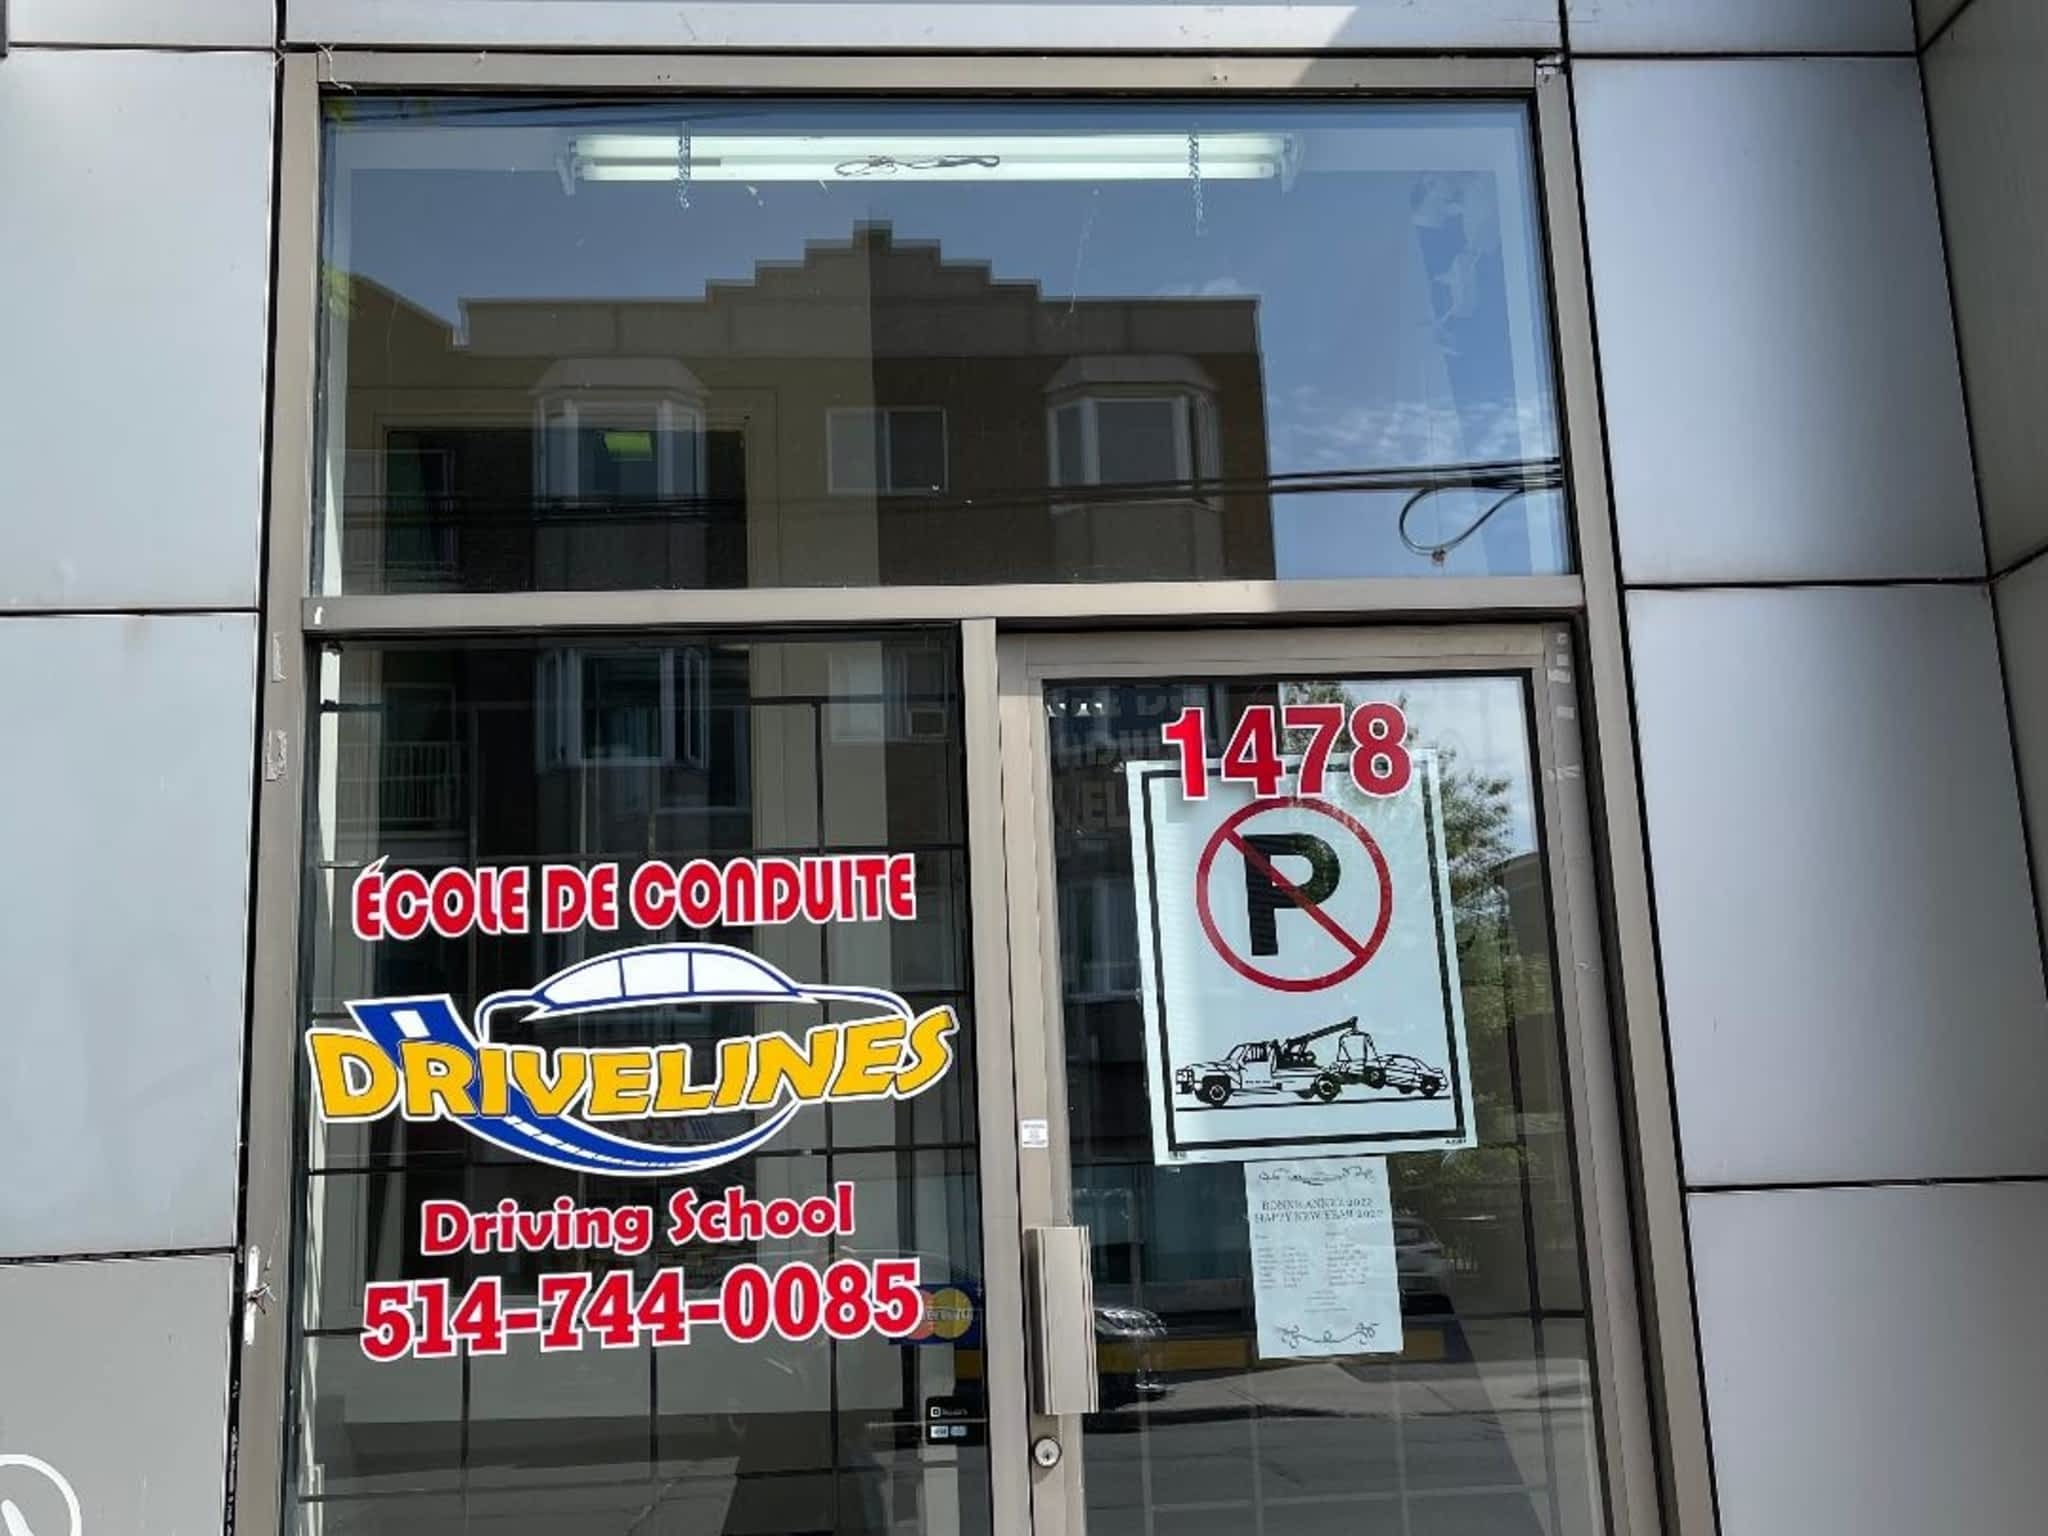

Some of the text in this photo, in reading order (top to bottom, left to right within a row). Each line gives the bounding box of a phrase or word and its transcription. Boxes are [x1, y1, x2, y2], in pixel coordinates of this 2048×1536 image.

[1162, 702, 1412, 800] 1478
[352, 853, 916, 940] ÉCOLE DE CONDUITE
[1243, 832, 1341, 956] P
[306, 1005, 960, 1122] DRIVELINES
[421, 1182, 855, 1256] Driving School
[1254, 1212, 1292, 1224] HAPPY
[1294, 1211, 1321, 1222] NEW
[1324, 1209, 1354, 1221] YEAR
[360, 1258, 922, 1360] 514-744-0085
